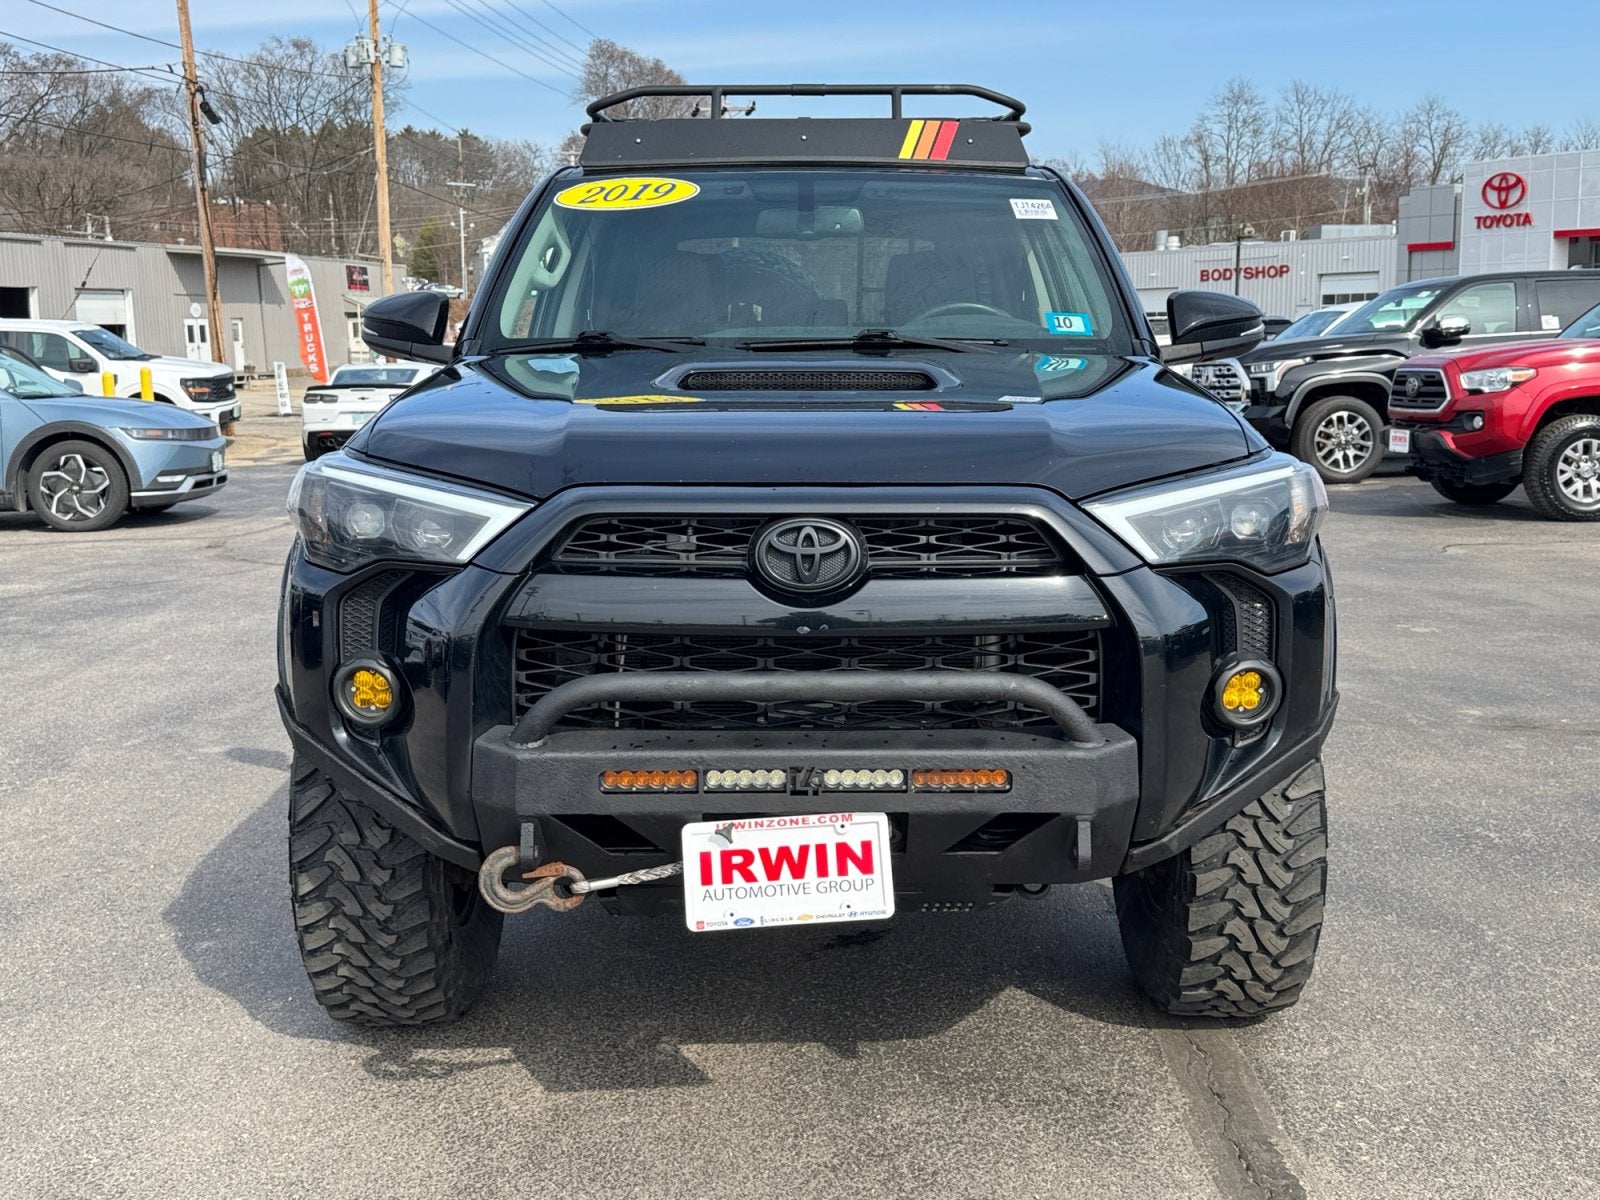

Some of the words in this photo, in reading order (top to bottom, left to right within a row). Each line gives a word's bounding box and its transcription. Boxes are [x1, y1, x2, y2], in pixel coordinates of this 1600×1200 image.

[577, 182, 677, 205] 2019
[1474, 212, 1533, 230] TOYOTA
[1053, 316, 1073, 329] 10
[300, 311, 319, 374] TRUCKS
[699, 839, 875, 887] IRWIN
[702, 881, 811, 903] AUTOMOTIVE
[815, 877, 875, 894] GROUP
